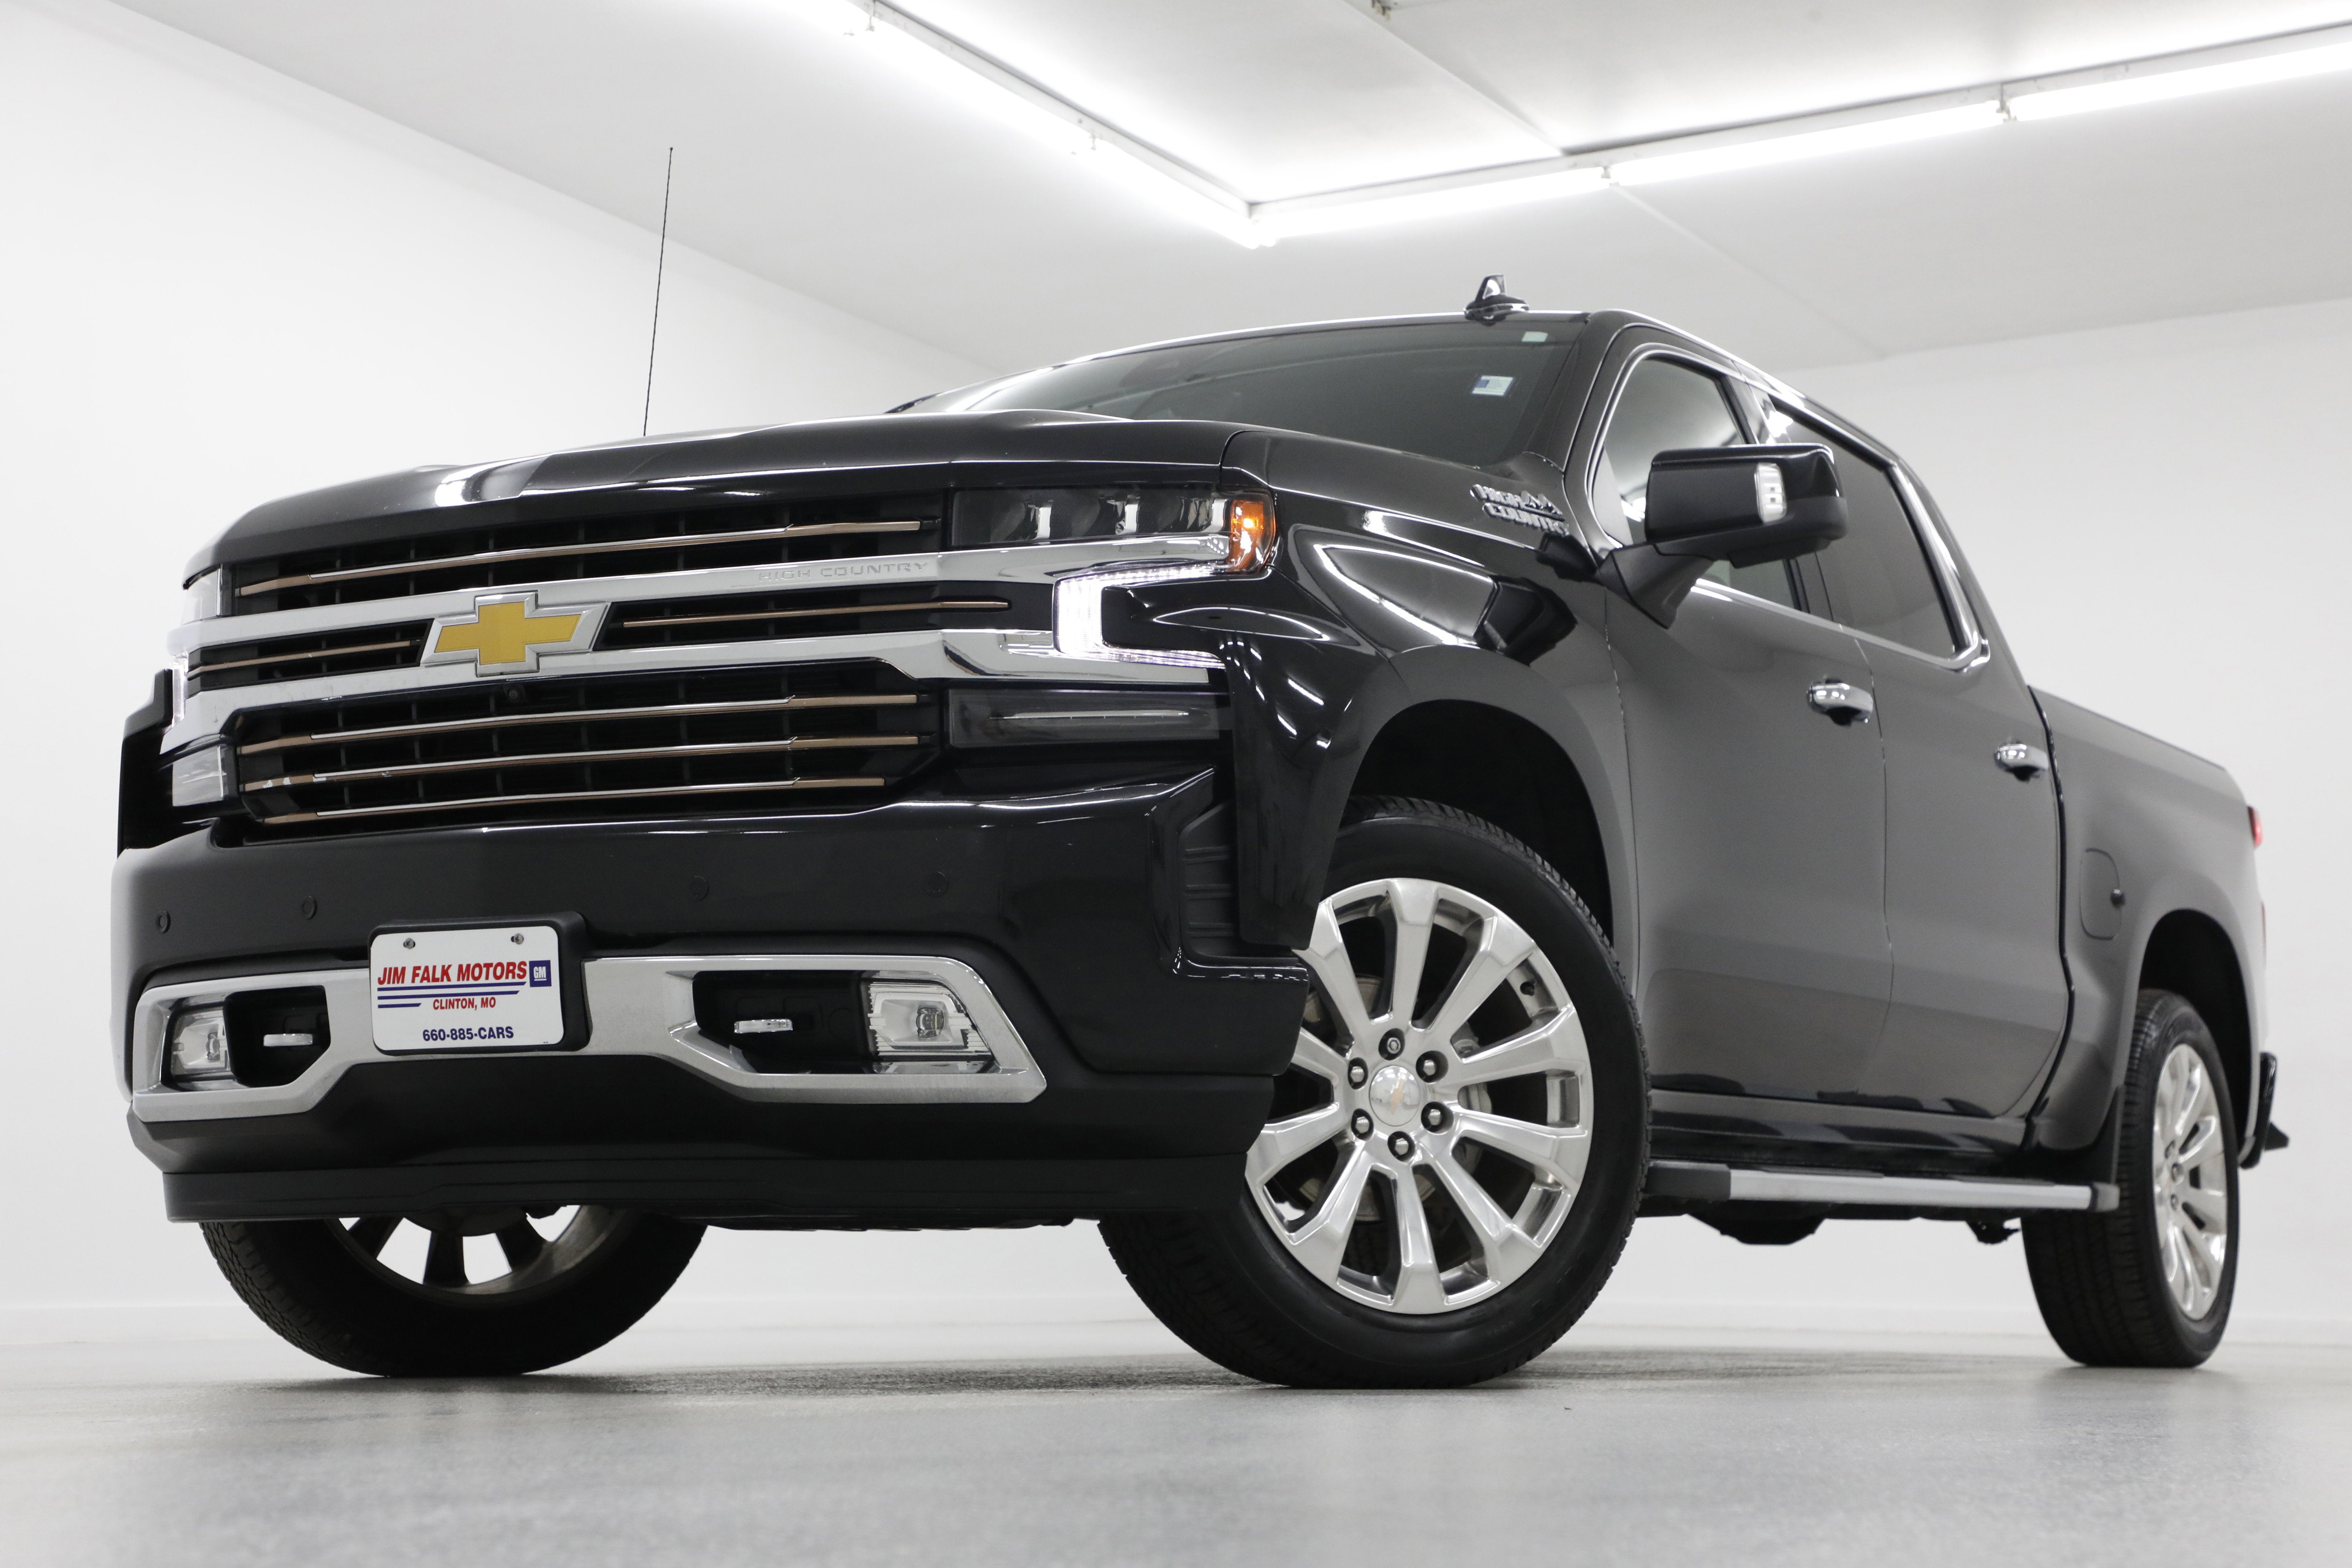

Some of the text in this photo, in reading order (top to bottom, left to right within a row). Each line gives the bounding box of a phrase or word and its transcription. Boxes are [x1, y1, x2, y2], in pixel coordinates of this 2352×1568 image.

[1471, 484, 1526, 509] HIGH
[759, 562, 928, 582] HIGH COUNTRY
[378, 961, 527, 985] JIM FALK MOTORS
[533, 966, 547, 979] GM
[433, 997, 496, 1011] CLINTON, MO
[423, 1026, 514, 1041] 660-885-CARS
